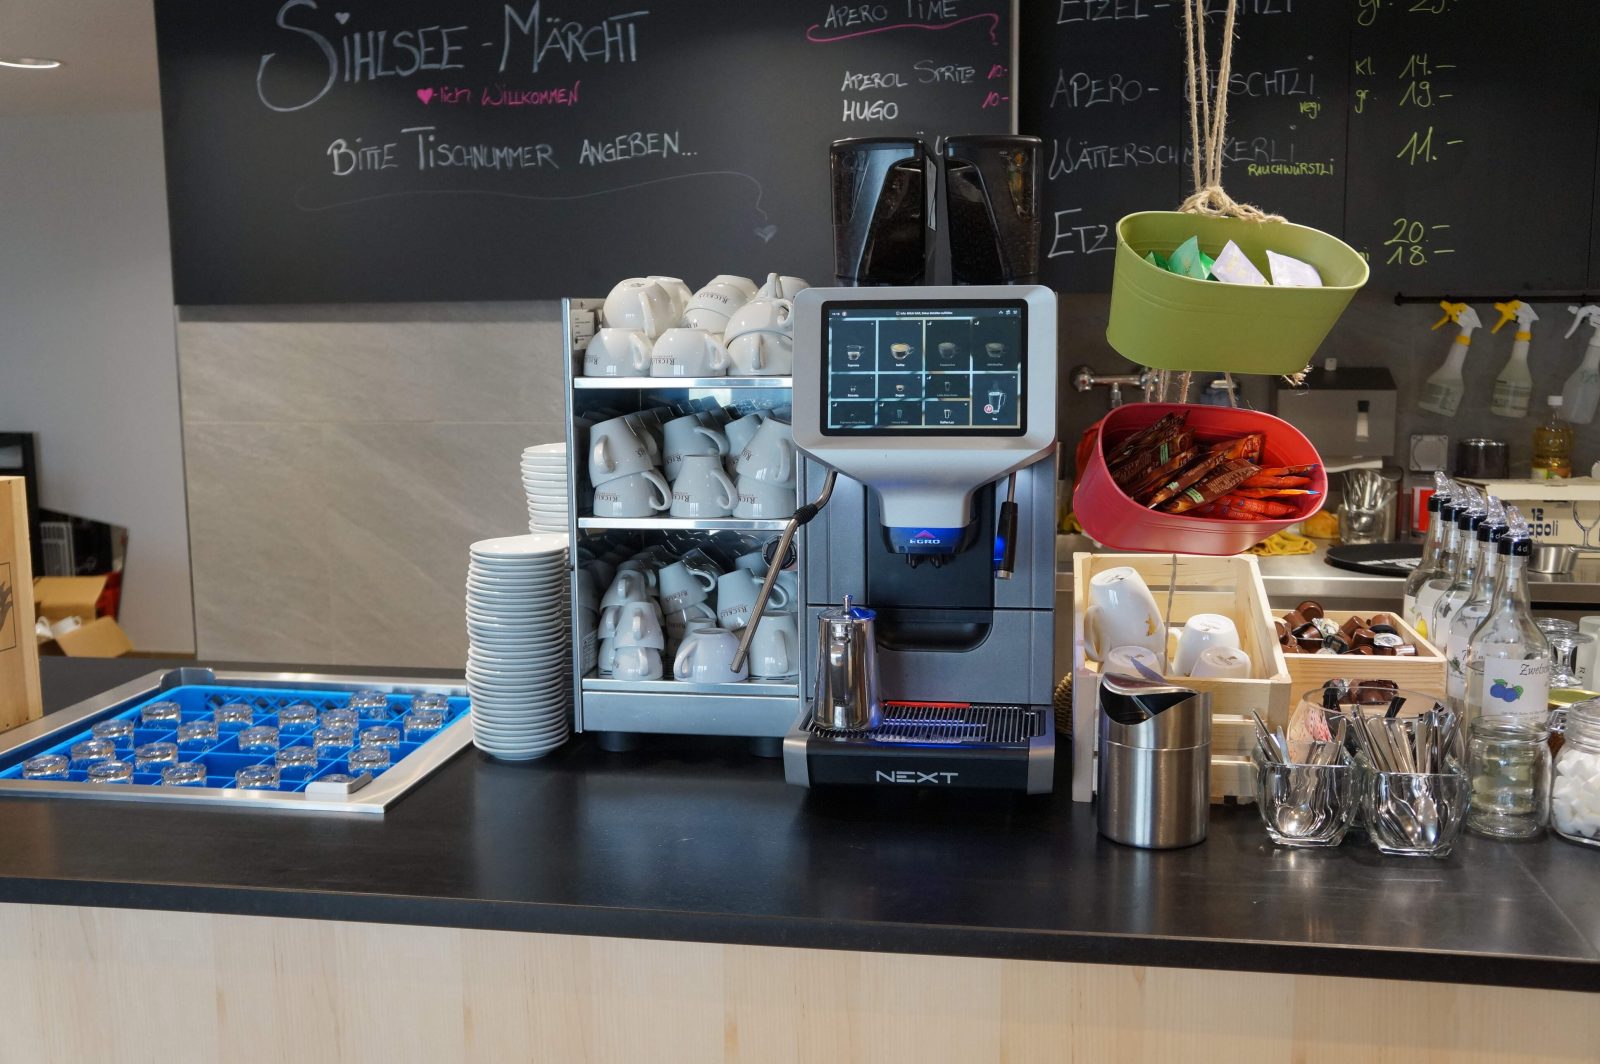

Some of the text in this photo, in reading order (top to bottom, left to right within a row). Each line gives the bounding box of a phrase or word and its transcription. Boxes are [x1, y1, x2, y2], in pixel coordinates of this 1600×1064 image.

[824, 4, 888, 29] APERO
[841, 70, 908, 92] APEROL
[481, 80, 581, 106] WILLKOMMEN
[842, 99, 898, 122] HUGO
[1531, 508, 1544, 521] 12
[1527, 520, 1559, 537] apoli
[875, 770, 959, 784] NEXT
